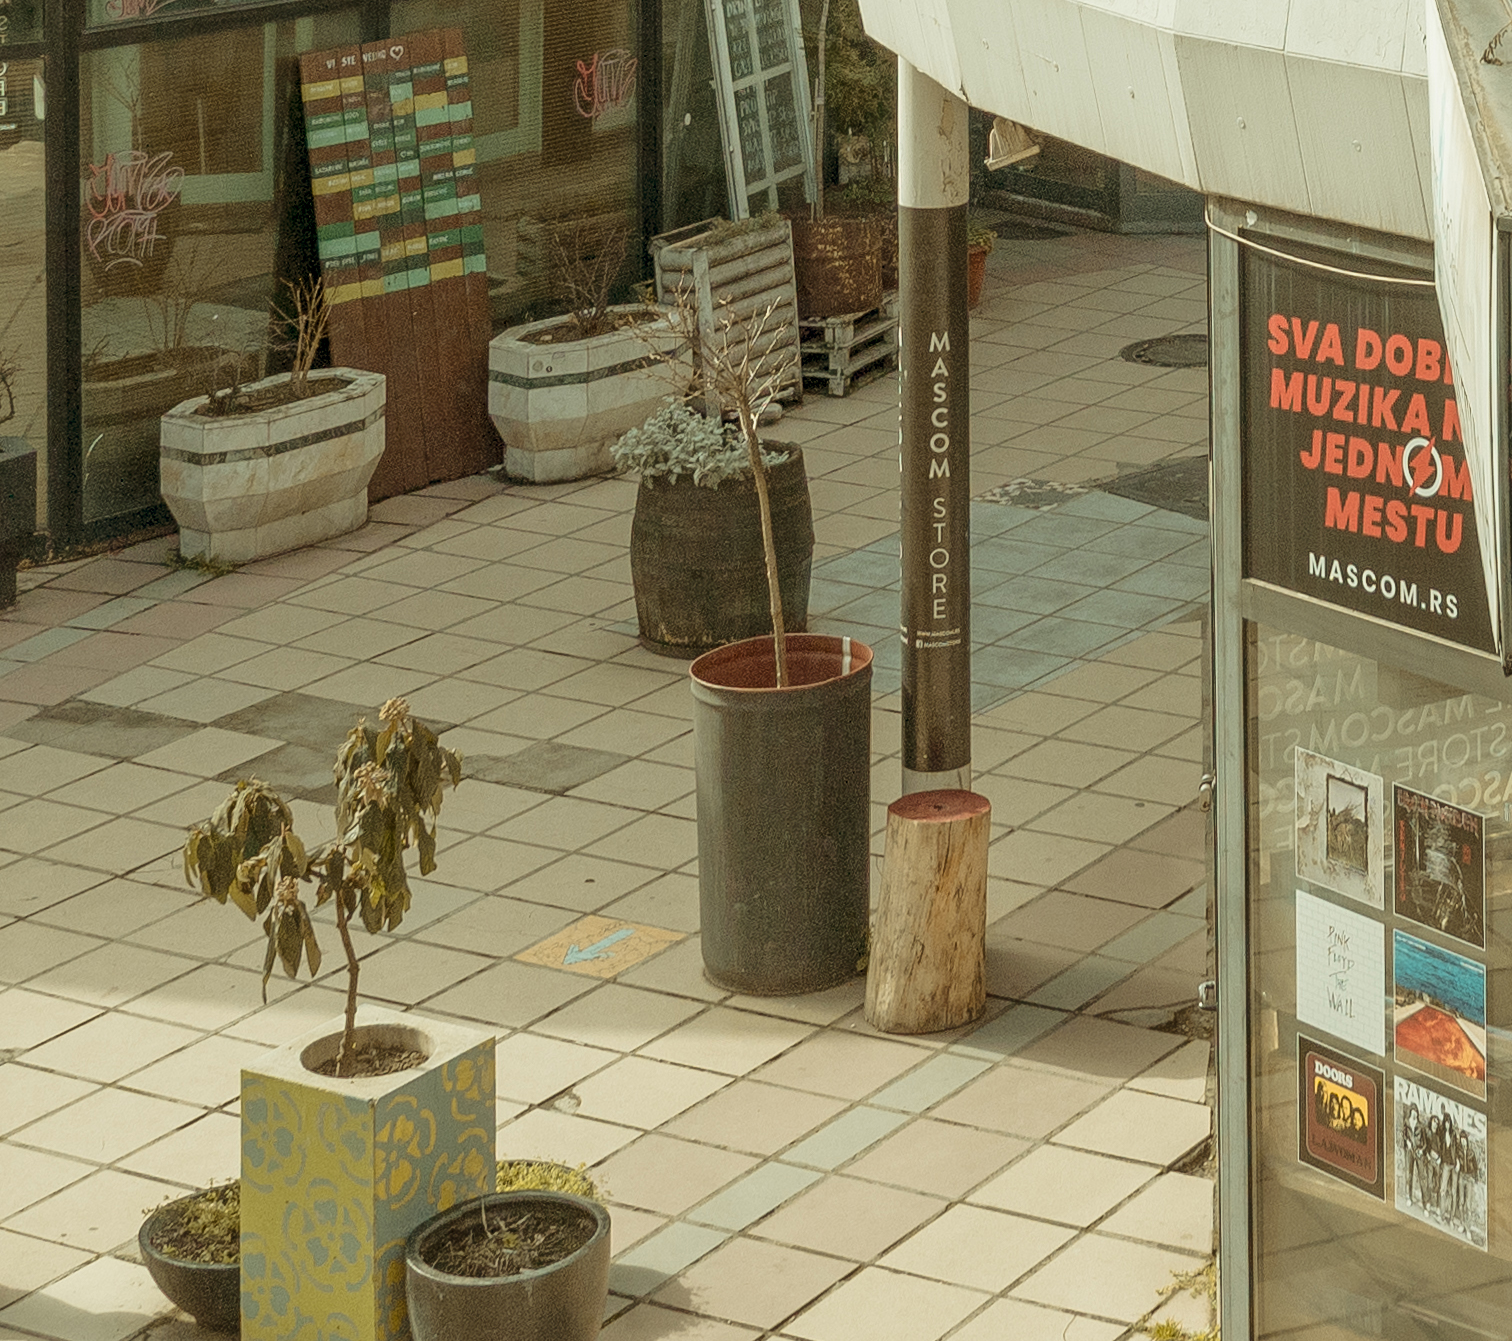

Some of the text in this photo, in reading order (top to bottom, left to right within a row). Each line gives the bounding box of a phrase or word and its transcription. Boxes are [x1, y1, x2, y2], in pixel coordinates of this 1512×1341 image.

[1267, 313, 1345, 366] SVA
[1269, 367, 1432, 437] MUZIKA
[928, 331, 951, 619] MASCOM STORE
[1299, 428, 1474, 503] JEDNOM
[1324, 487, 1463, 554] MESTU
[1307, 552, 1460, 620] MASCOM.RS
[1314, 1060, 1353, 1089] DOORS
[1395, 1079, 1486, 1136] RAMONES
